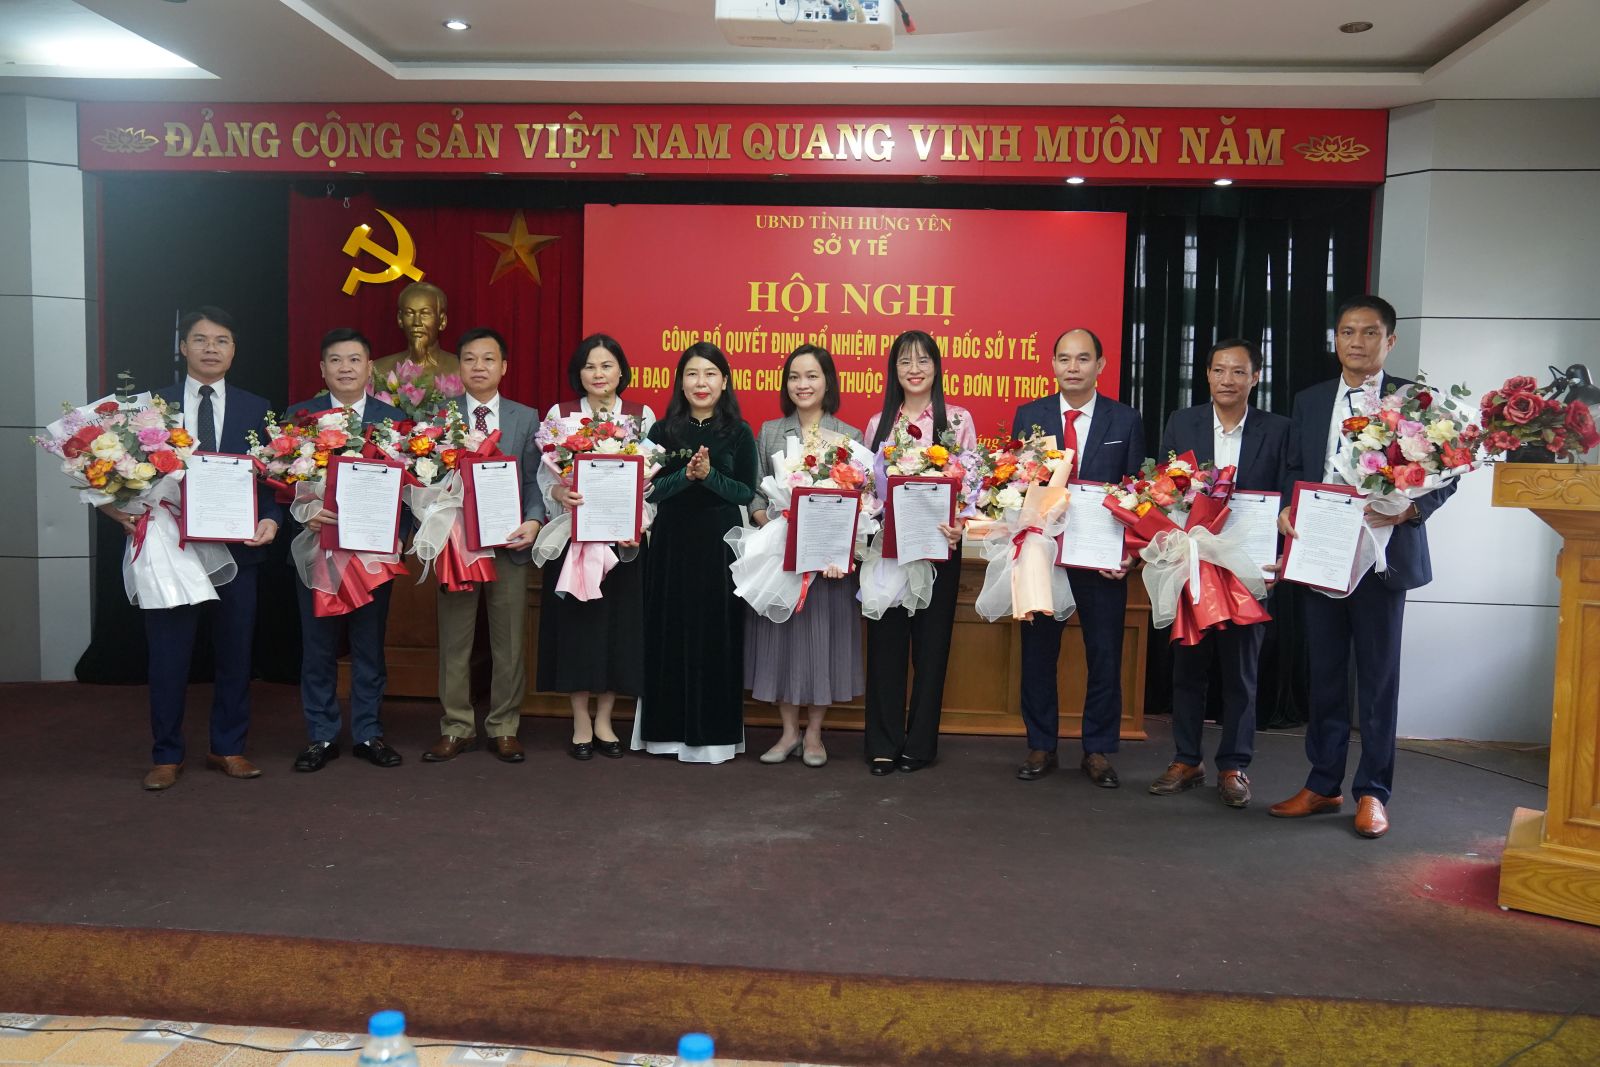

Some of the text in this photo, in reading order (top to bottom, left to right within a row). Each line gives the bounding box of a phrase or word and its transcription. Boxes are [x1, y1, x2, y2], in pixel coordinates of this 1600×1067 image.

[164, 108, 1284, 168] ĐẢNG CỘNG SẢN VIỆT NAM QUANG VINH MUÔN NĂM
[756, 212, 952, 231] UBND TỈNH HƯNG YÊN
[813, 233, 892, 256] SỞ Y TẾ
[747, 273, 956, 326] HỘI NGHỊ
[725, 324, 768, 355] QUYẾT
[771, 332, 805, 359] ĐỊNH
[831, 330, 876, 361] NHIỆM
[952, 329, 981, 359] ĐỐC
[985, 330, 1005, 360] SỞ
[1008, 338, 1016, 360] Y
[1020, 332, 1040, 363] TẾ,
[643, 367, 670, 393] ĐẠO
[755, 366, 784, 392] CHỨ
[839, 368, 883, 398] THUỘC
[943, 370, 960, 396] ÁC
[963, 373, 992, 397] ĐƠN
[997, 376, 1010, 402] VỊ
[1013, 374, 1049, 401] TRỰC
